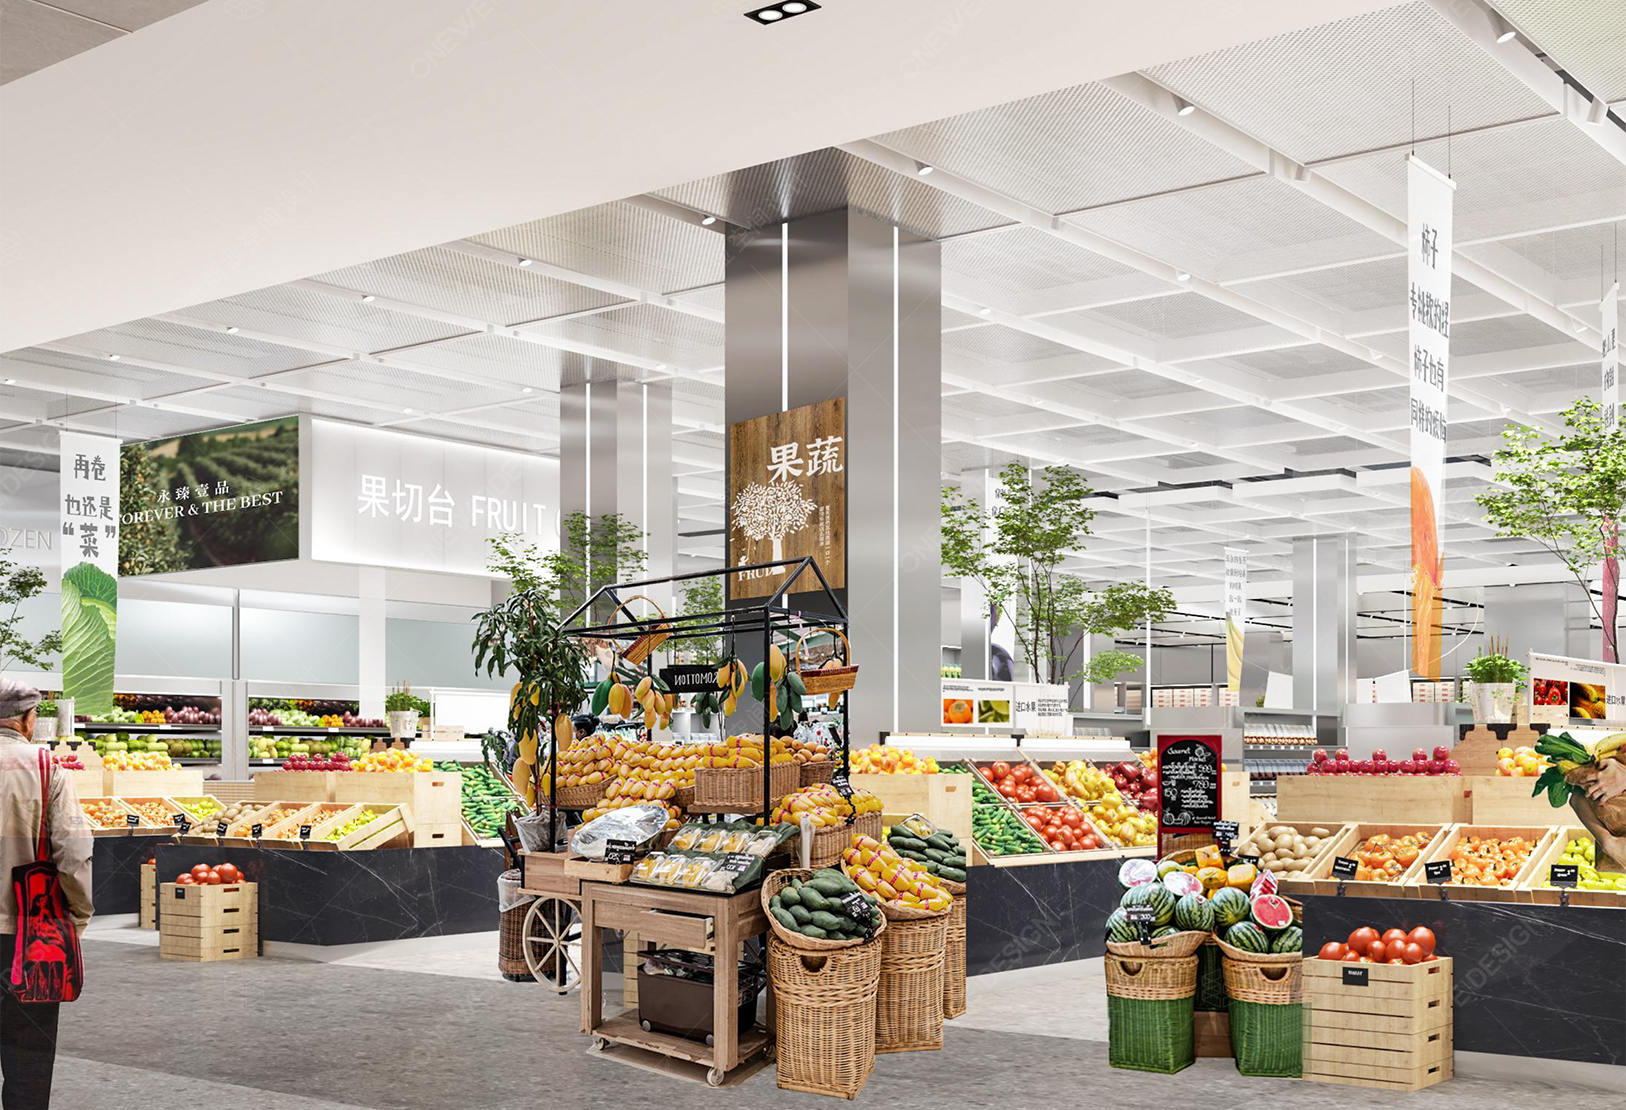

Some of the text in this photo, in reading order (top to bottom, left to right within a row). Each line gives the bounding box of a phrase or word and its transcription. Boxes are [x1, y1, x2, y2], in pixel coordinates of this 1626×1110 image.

[1421, 222, 1438, 270] 柿子
[1414, 344, 1444, 392] 柿子也有
[74, 453, 106, 482] 再卷
[767, 435, 844, 483] 果蔬
[65, 494, 113, 521] 也还是
[121, 491, 284, 526] OREVER & THE BEST
[358, 474, 456, 528] 果切台
[472, 495, 547, 536] FRUIT
[1015, 701, 1037, 713] 进口水果
